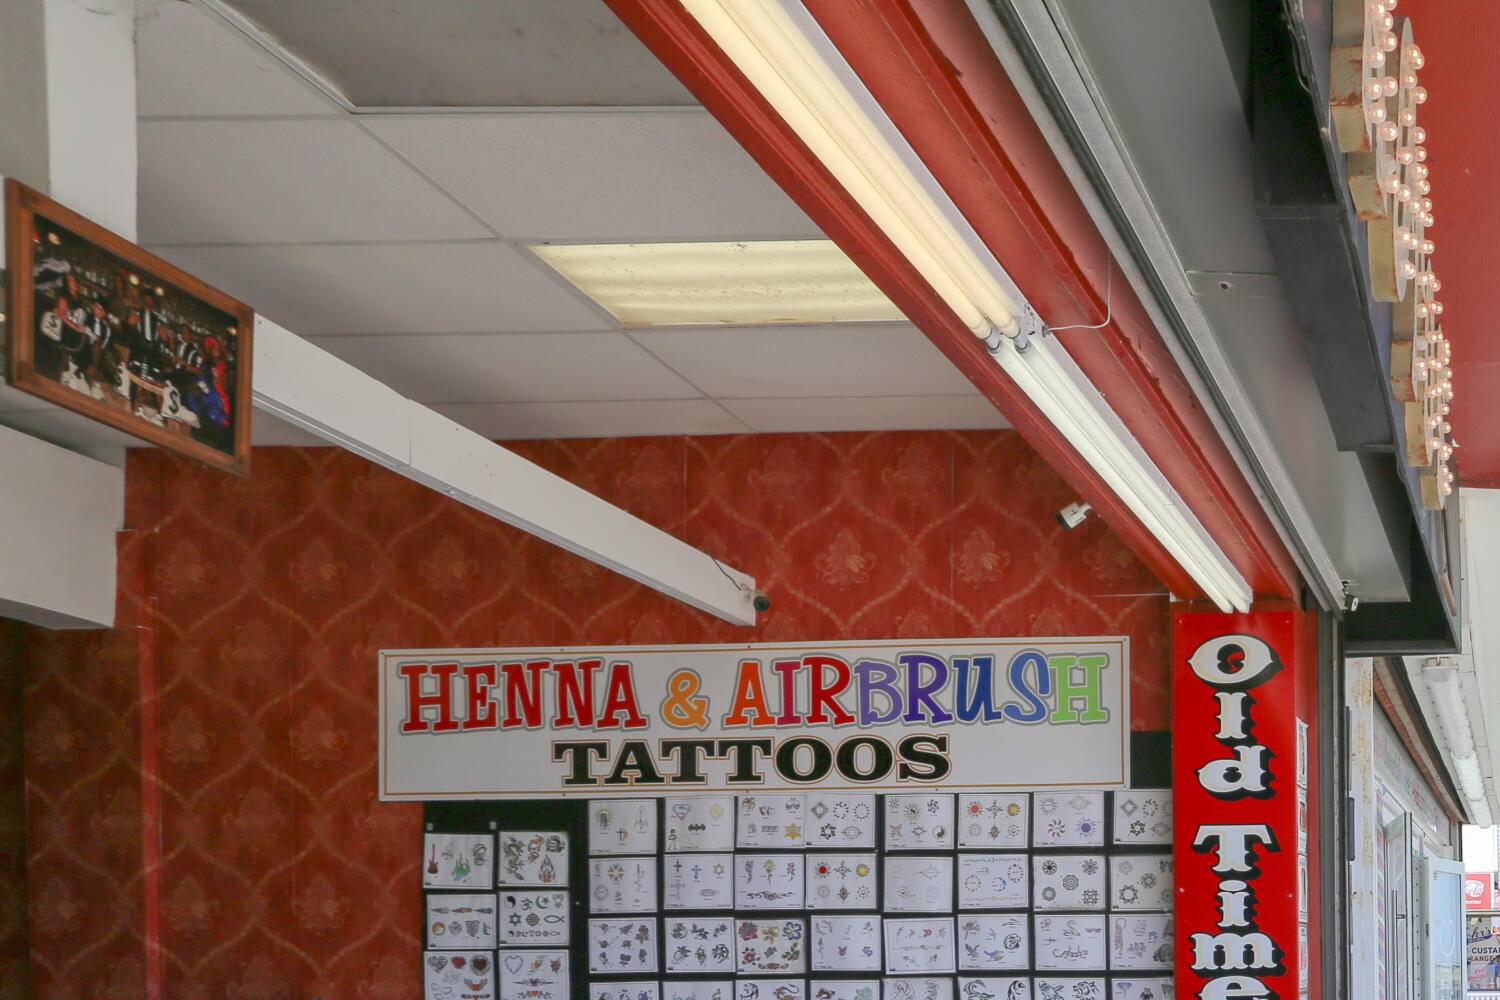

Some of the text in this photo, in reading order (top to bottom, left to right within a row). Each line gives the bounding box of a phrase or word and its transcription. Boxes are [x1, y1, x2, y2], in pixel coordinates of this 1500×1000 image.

[399, 650, 1112, 734] HENNA & AIRBRUSH
[1188, 634, 1283, 799] Old
[553, 733, 952, 788] TATTOOS
